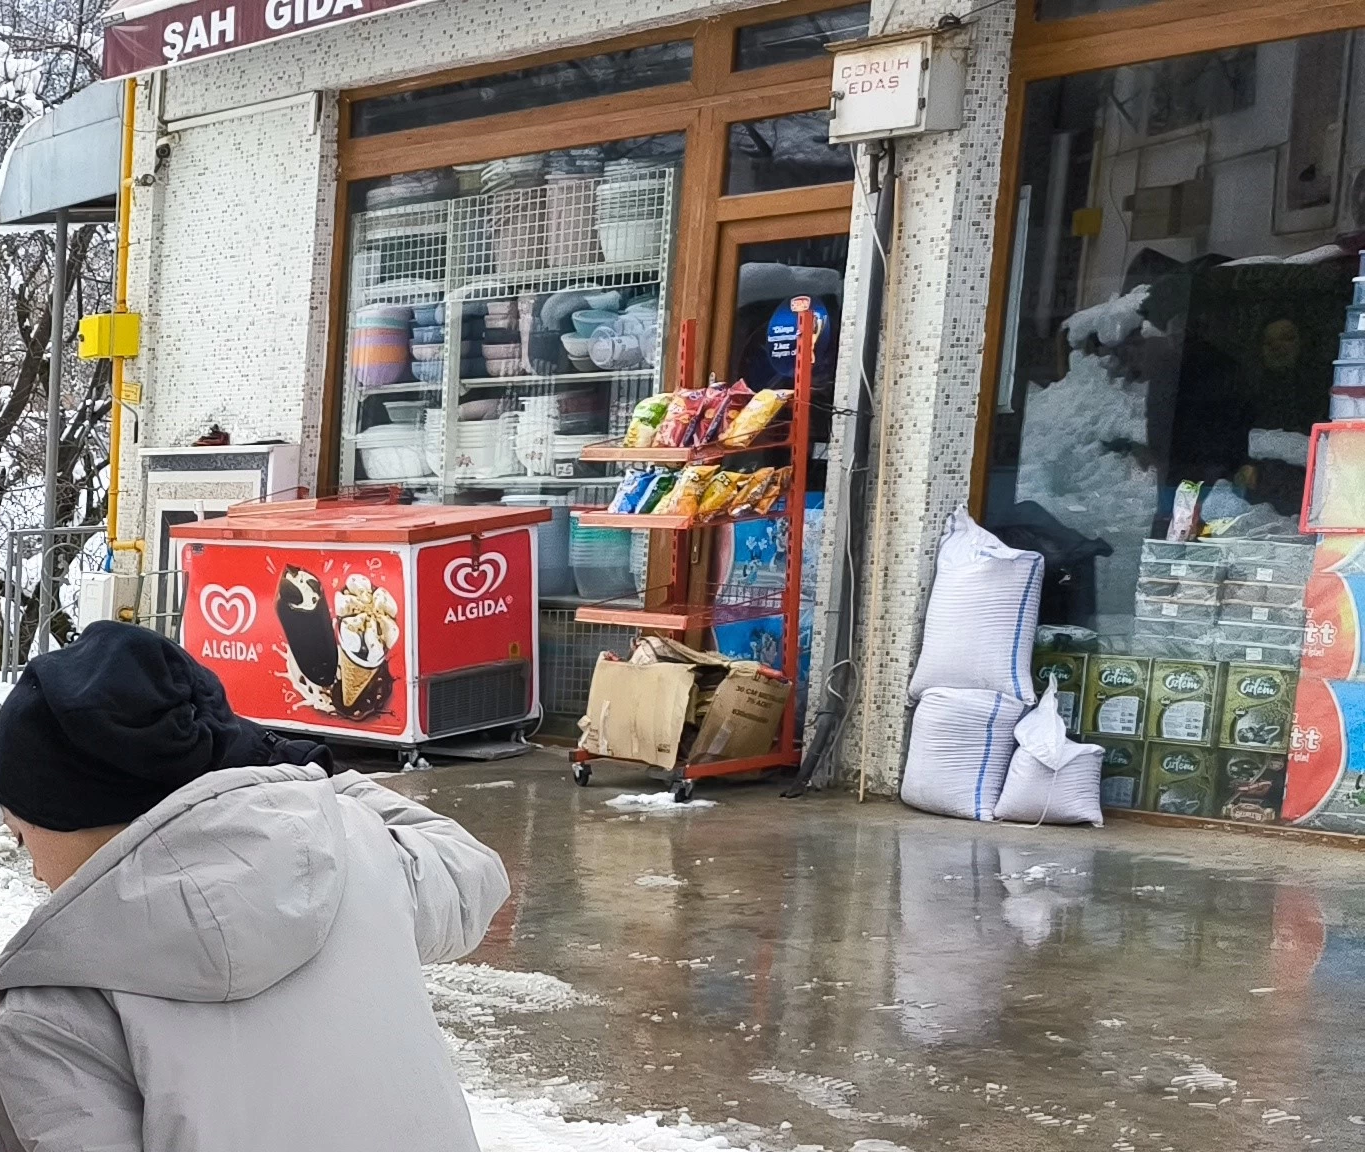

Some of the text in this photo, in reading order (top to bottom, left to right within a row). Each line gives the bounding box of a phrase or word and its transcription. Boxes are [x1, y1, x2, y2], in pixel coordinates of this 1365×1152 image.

[162, 0, 363, 64] ŞAH GIDA
[841, 58, 909, 85] ÇORUH
[848, 76, 900, 95] EDAŞ
